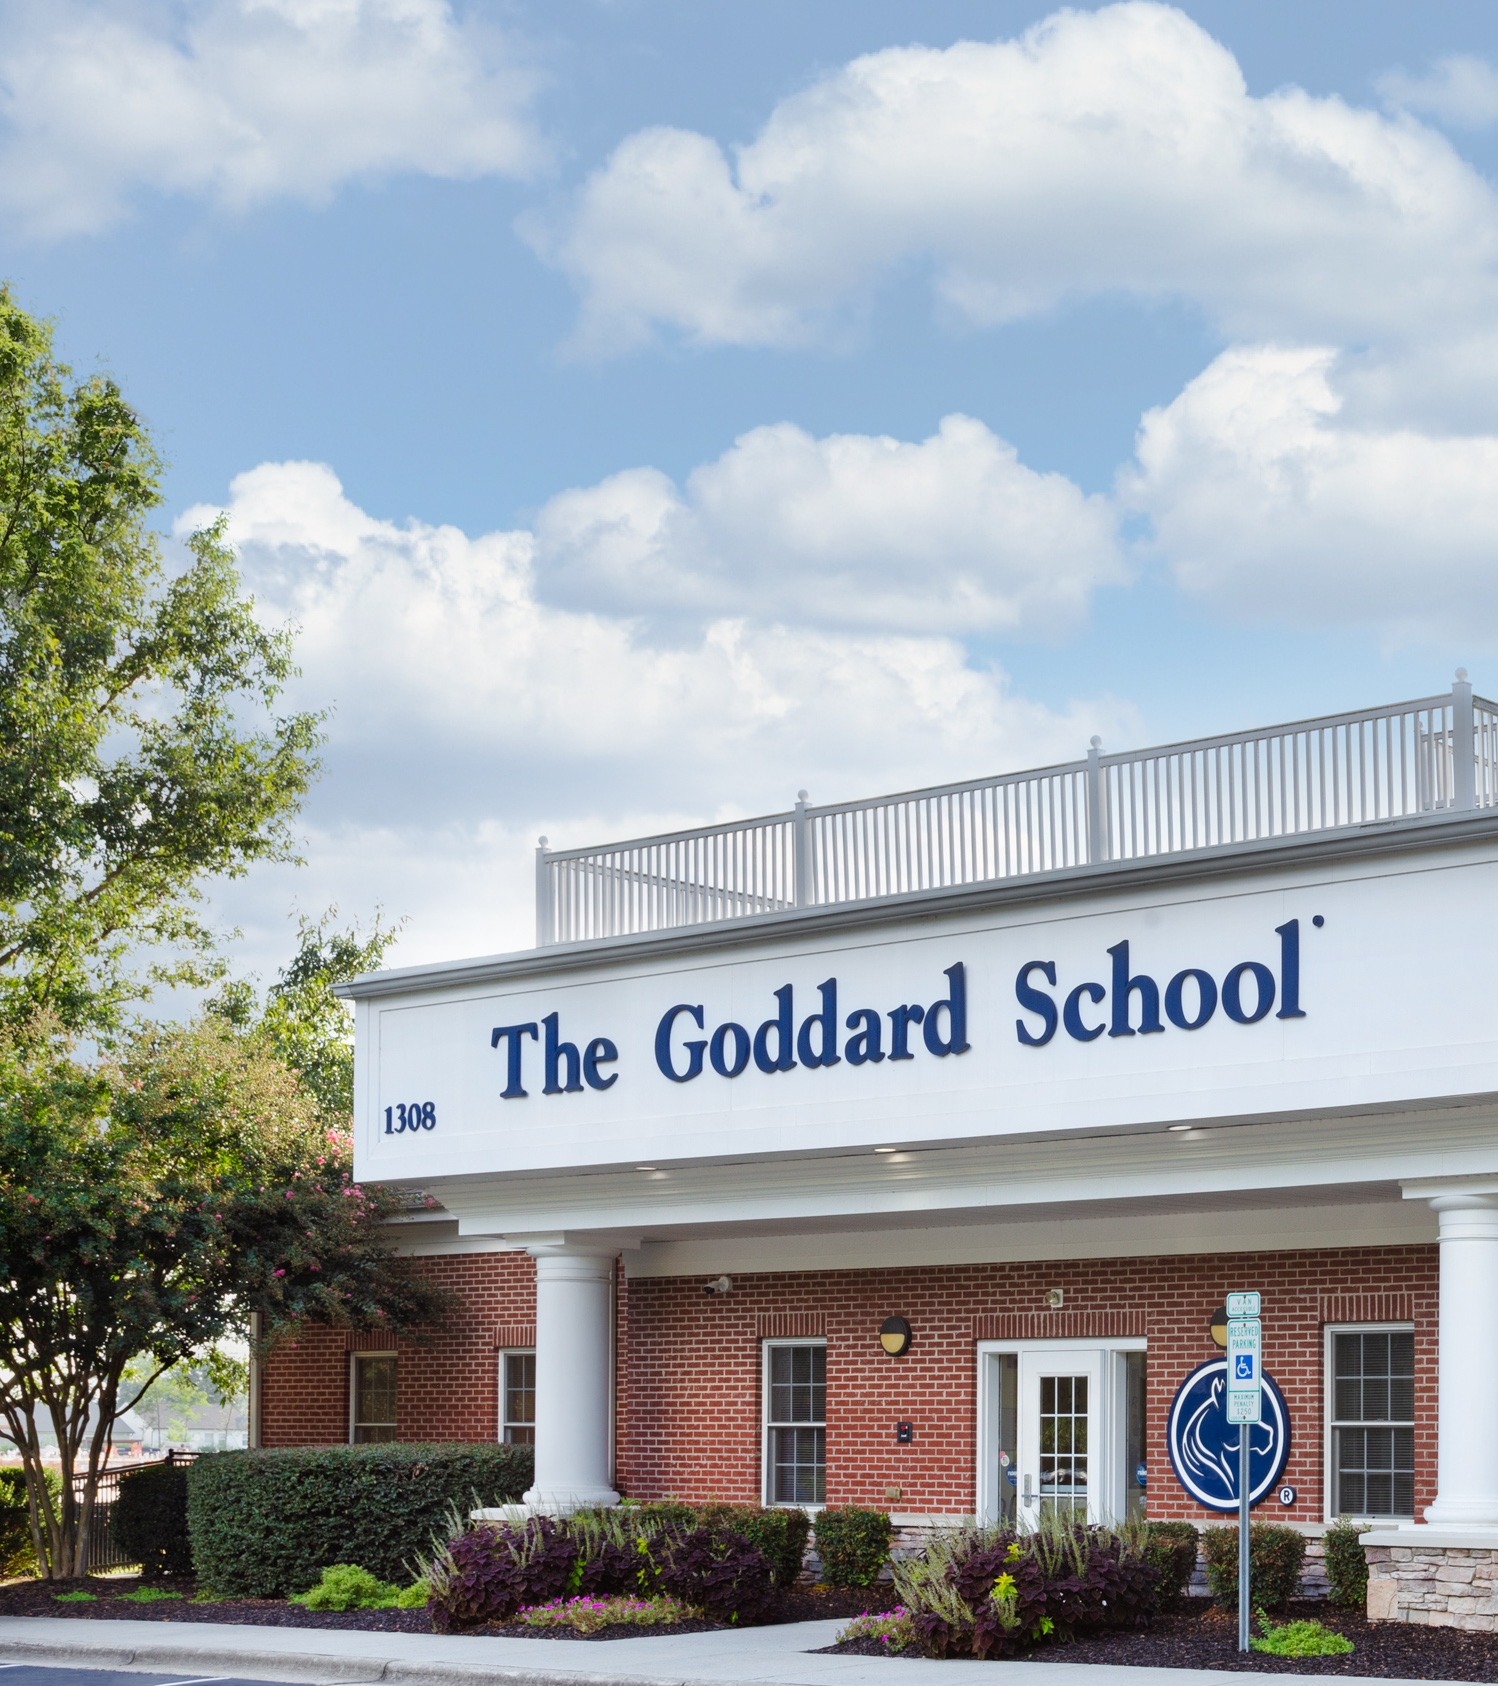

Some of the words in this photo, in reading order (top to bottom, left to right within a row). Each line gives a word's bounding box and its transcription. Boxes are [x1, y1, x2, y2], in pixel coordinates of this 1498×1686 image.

[491, 1011, 619, 1099] The
[655, 961, 971, 1082] Goddard
[1016, 918, 1307, 1046] School
[384, 1101, 437, 1134] 1308
[1230, 1326, 1258, 1337] RESERVED
[1232, 1338, 1257, 1349] PARKING
[1237, 1408, 1251, 1416] $250
